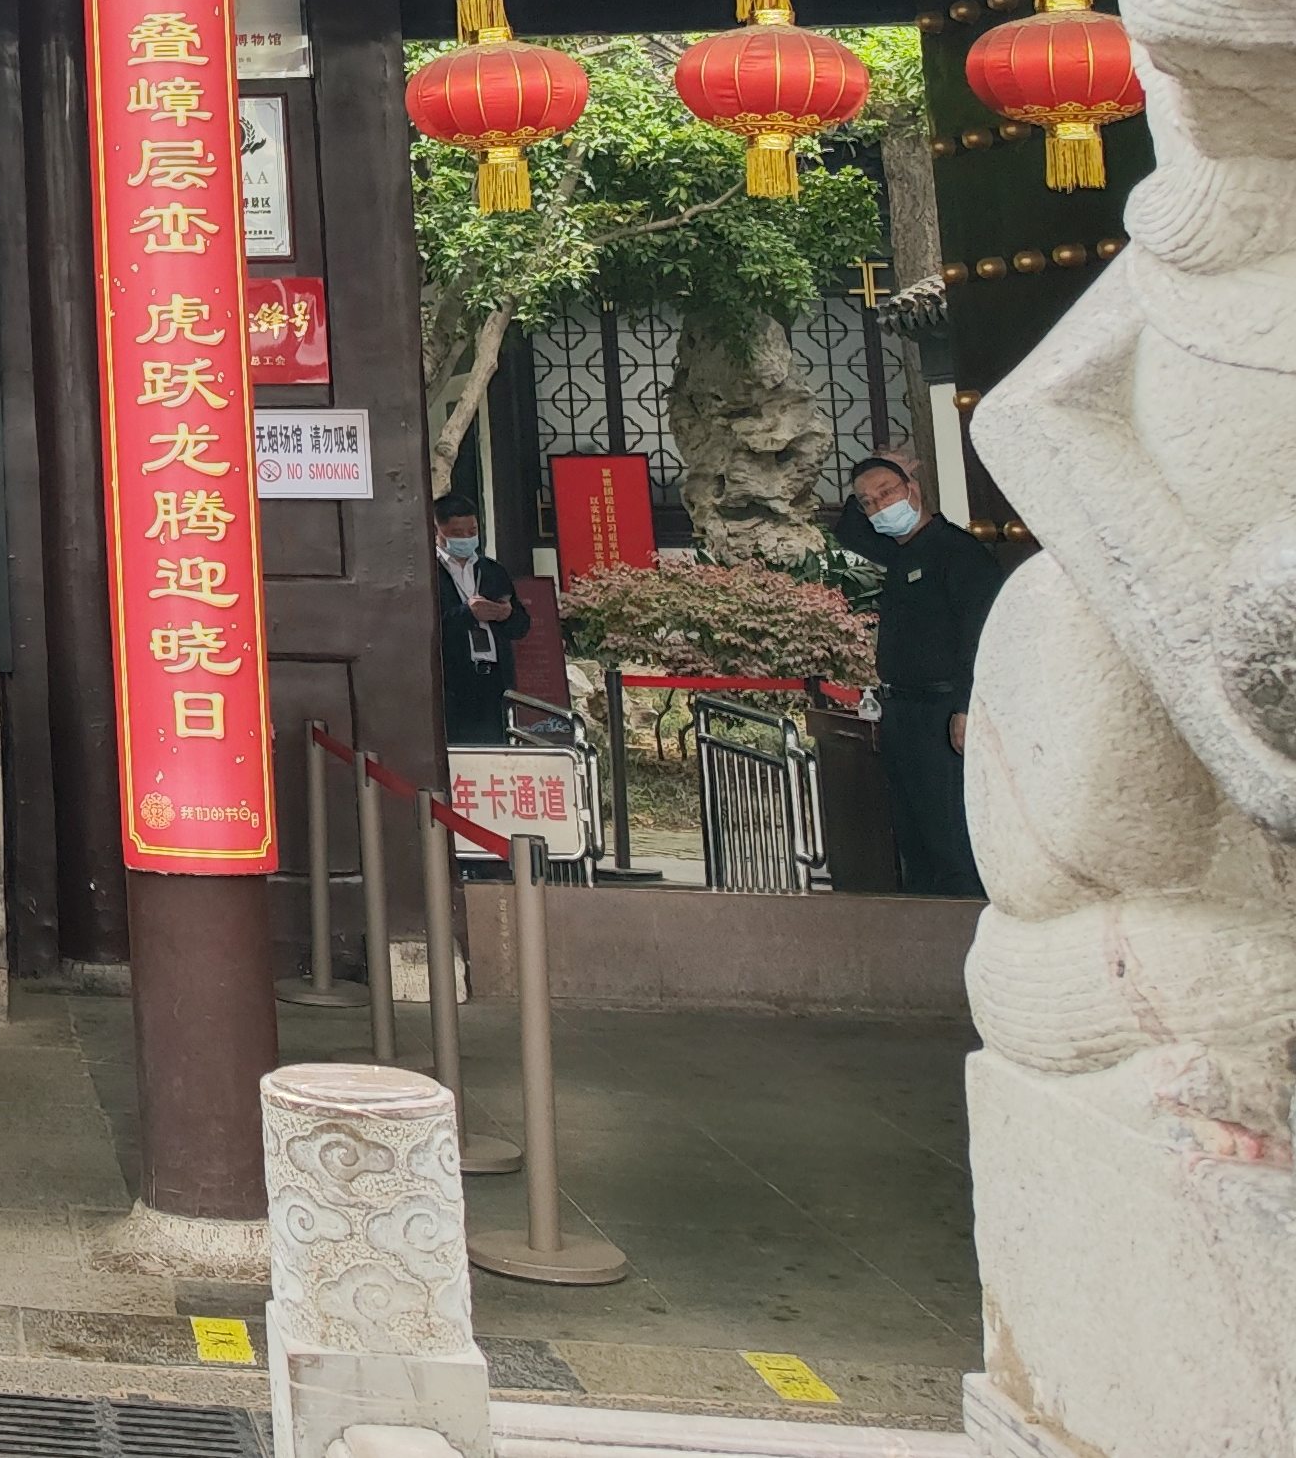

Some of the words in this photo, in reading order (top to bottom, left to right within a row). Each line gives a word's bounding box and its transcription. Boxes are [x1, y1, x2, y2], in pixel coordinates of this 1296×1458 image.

[256, 425, 303, 454] 无烟场馆
[310, 425, 359, 454] 请勿吸烟
[287, 463, 303, 480] NO
[309, 463, 360, 480] SMOKING
[452, 773, 567, 821] 年卡通道
